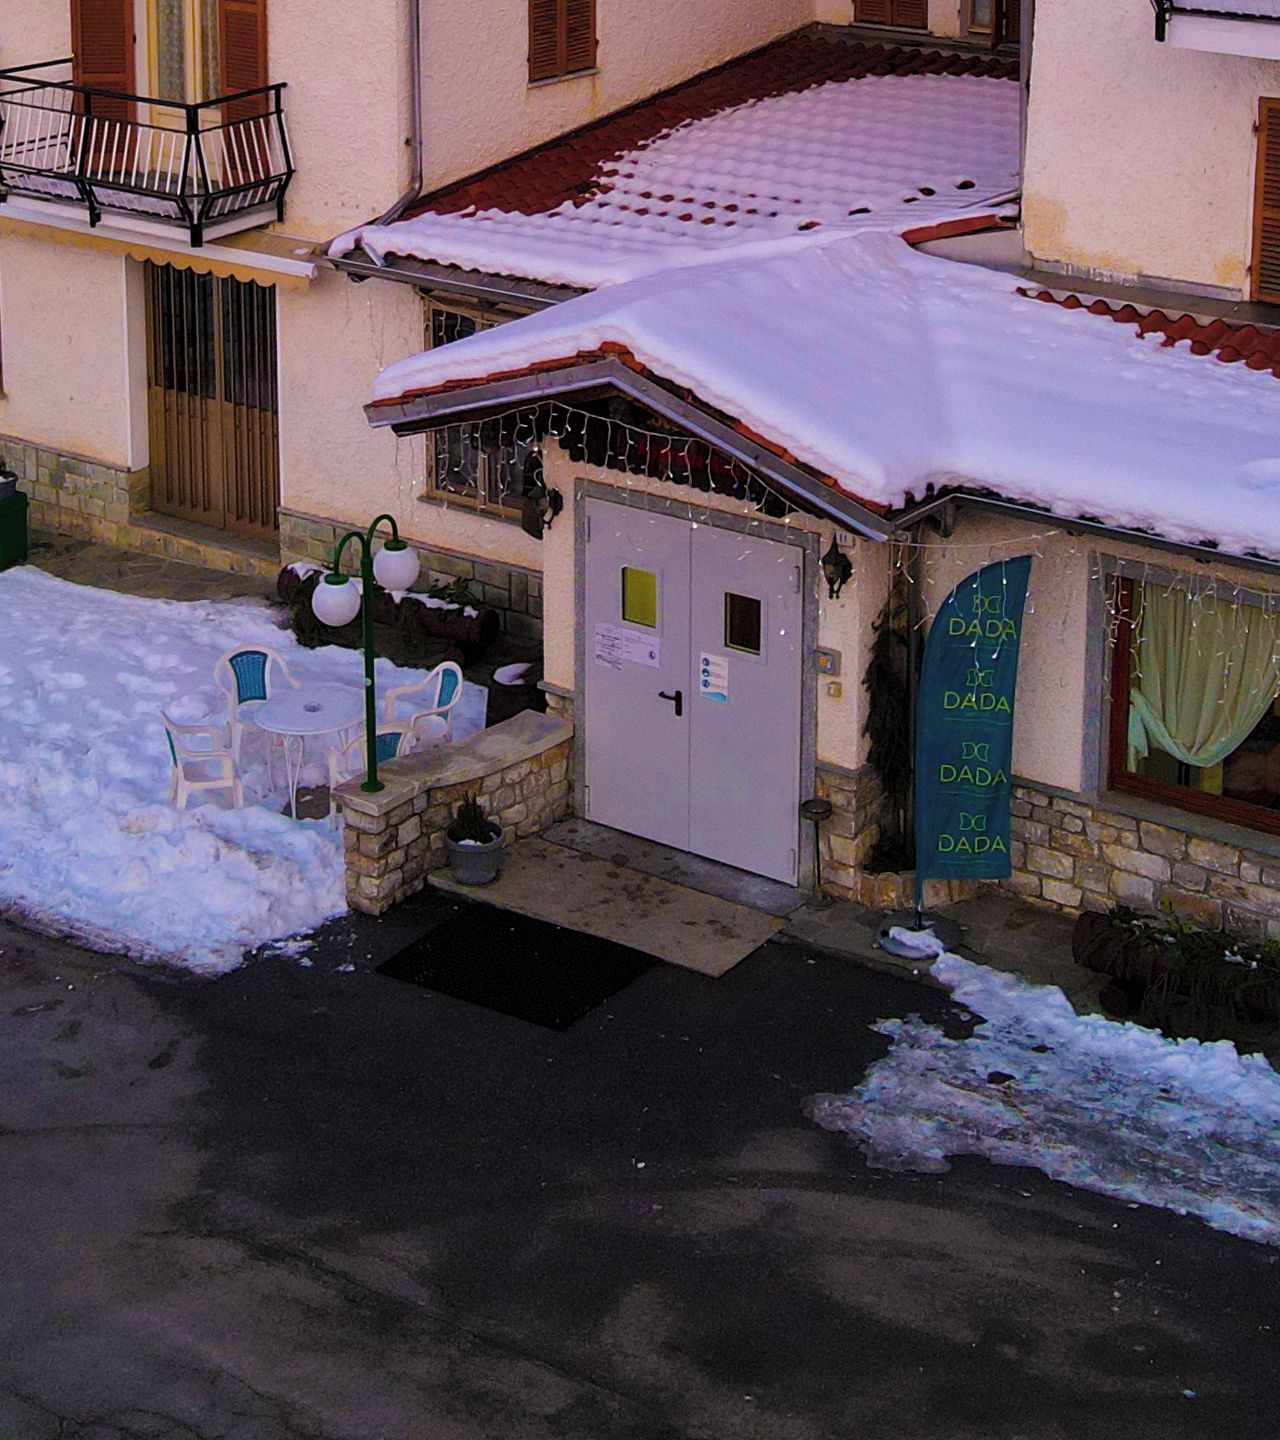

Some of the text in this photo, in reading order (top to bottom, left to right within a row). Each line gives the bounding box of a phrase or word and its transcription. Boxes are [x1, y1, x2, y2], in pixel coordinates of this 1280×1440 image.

[949, 617, 1016, 640] DADA
[943, 691, 1011, 714] DADA
[940, 764, 1008, 786] DADA
[938, 834, 1007, 854] DADA
